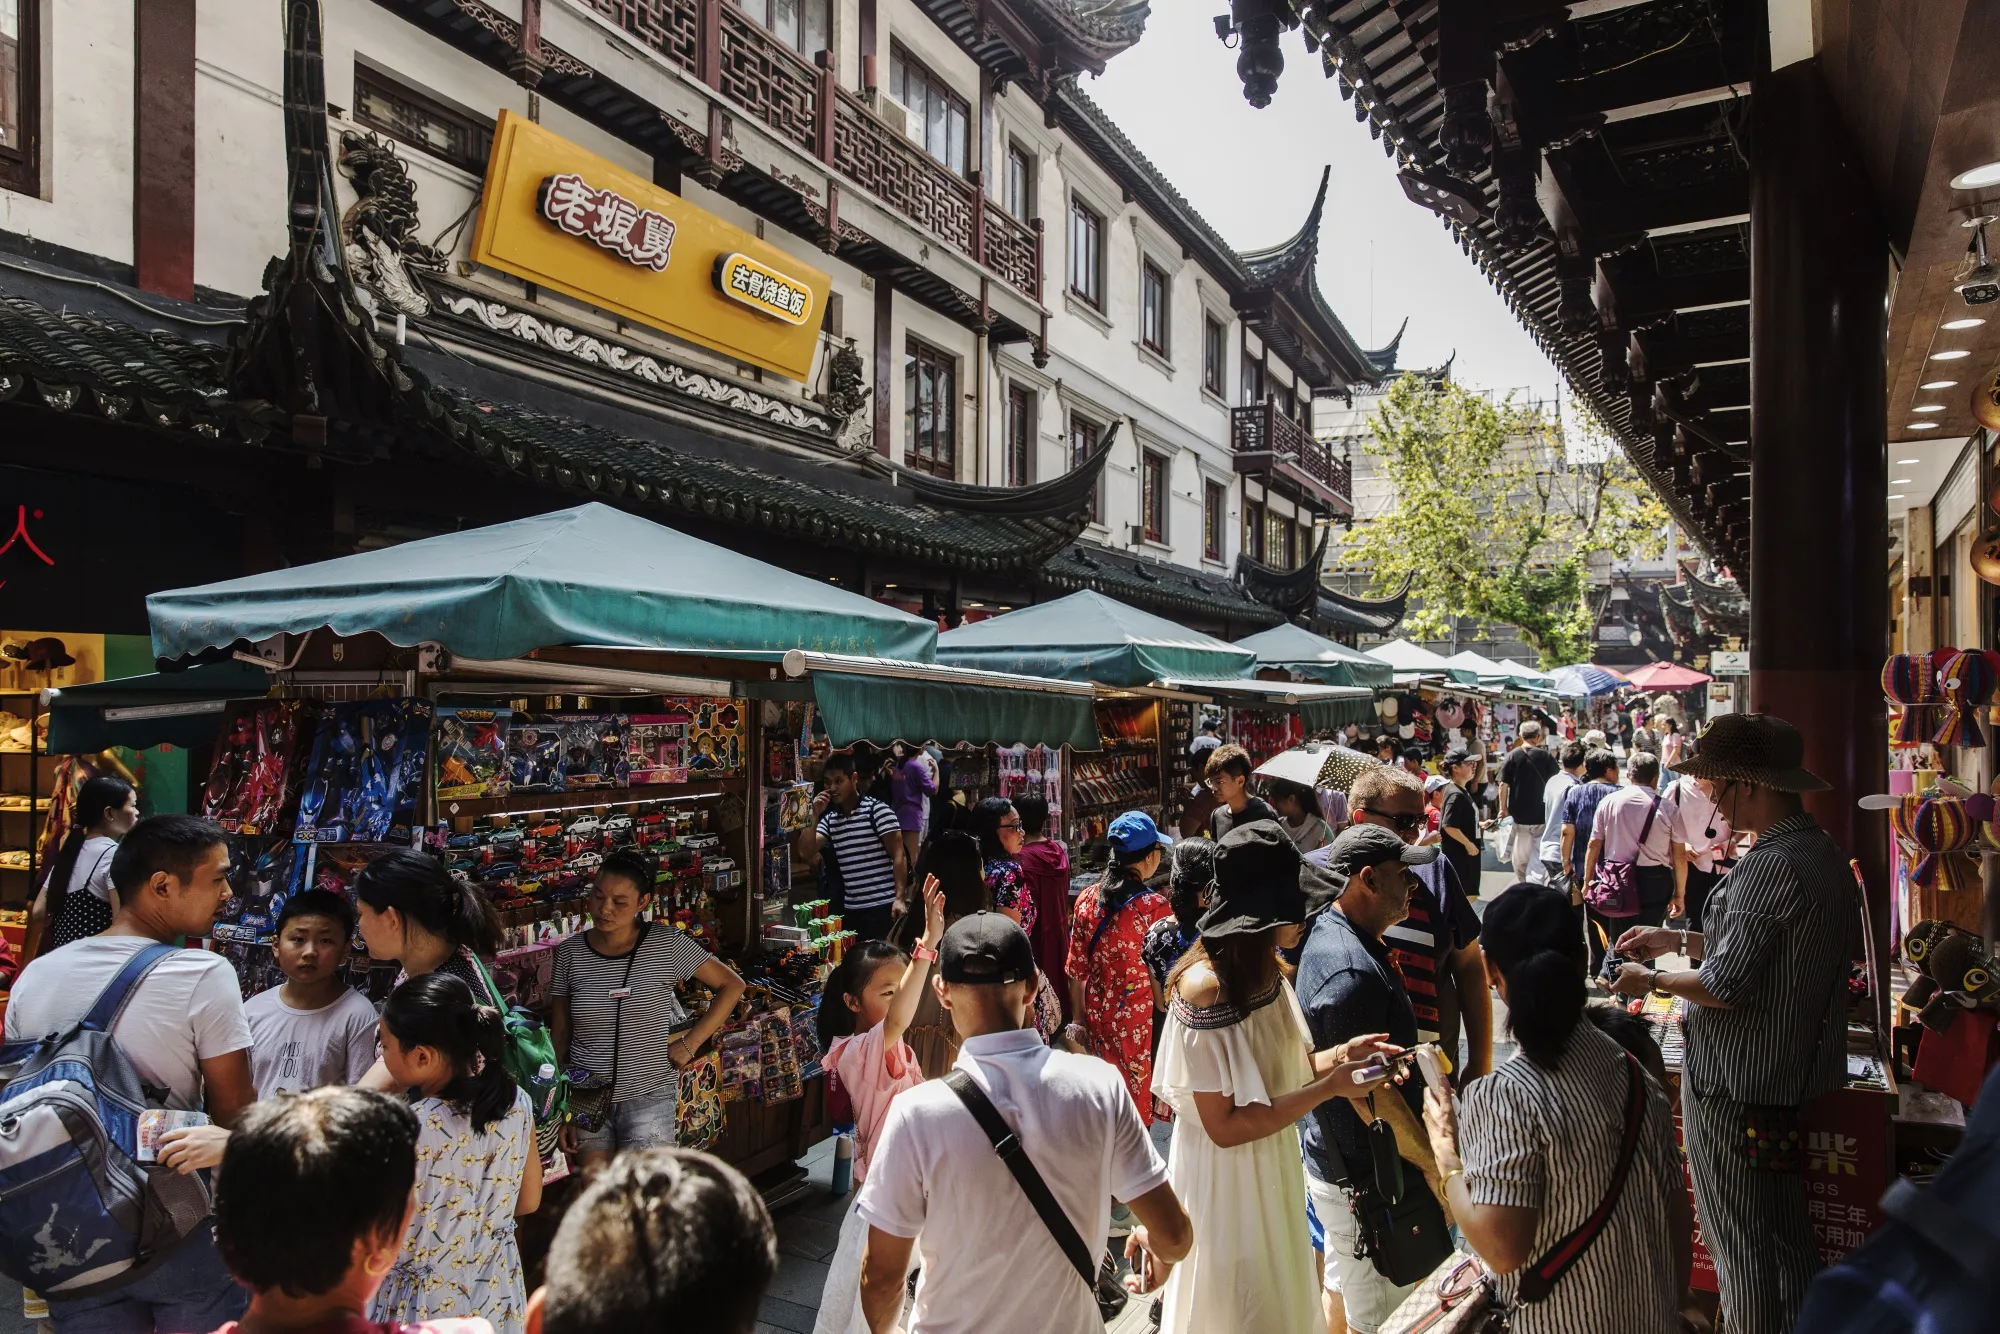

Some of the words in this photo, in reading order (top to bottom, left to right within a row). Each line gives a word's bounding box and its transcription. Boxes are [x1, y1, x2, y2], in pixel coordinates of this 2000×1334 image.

[550, 177, 673, 265] 老娘舅
[731, 264, 806, 317] 去骨烧鱼饭
[1806, 1131, 1860, 1177] 柴
